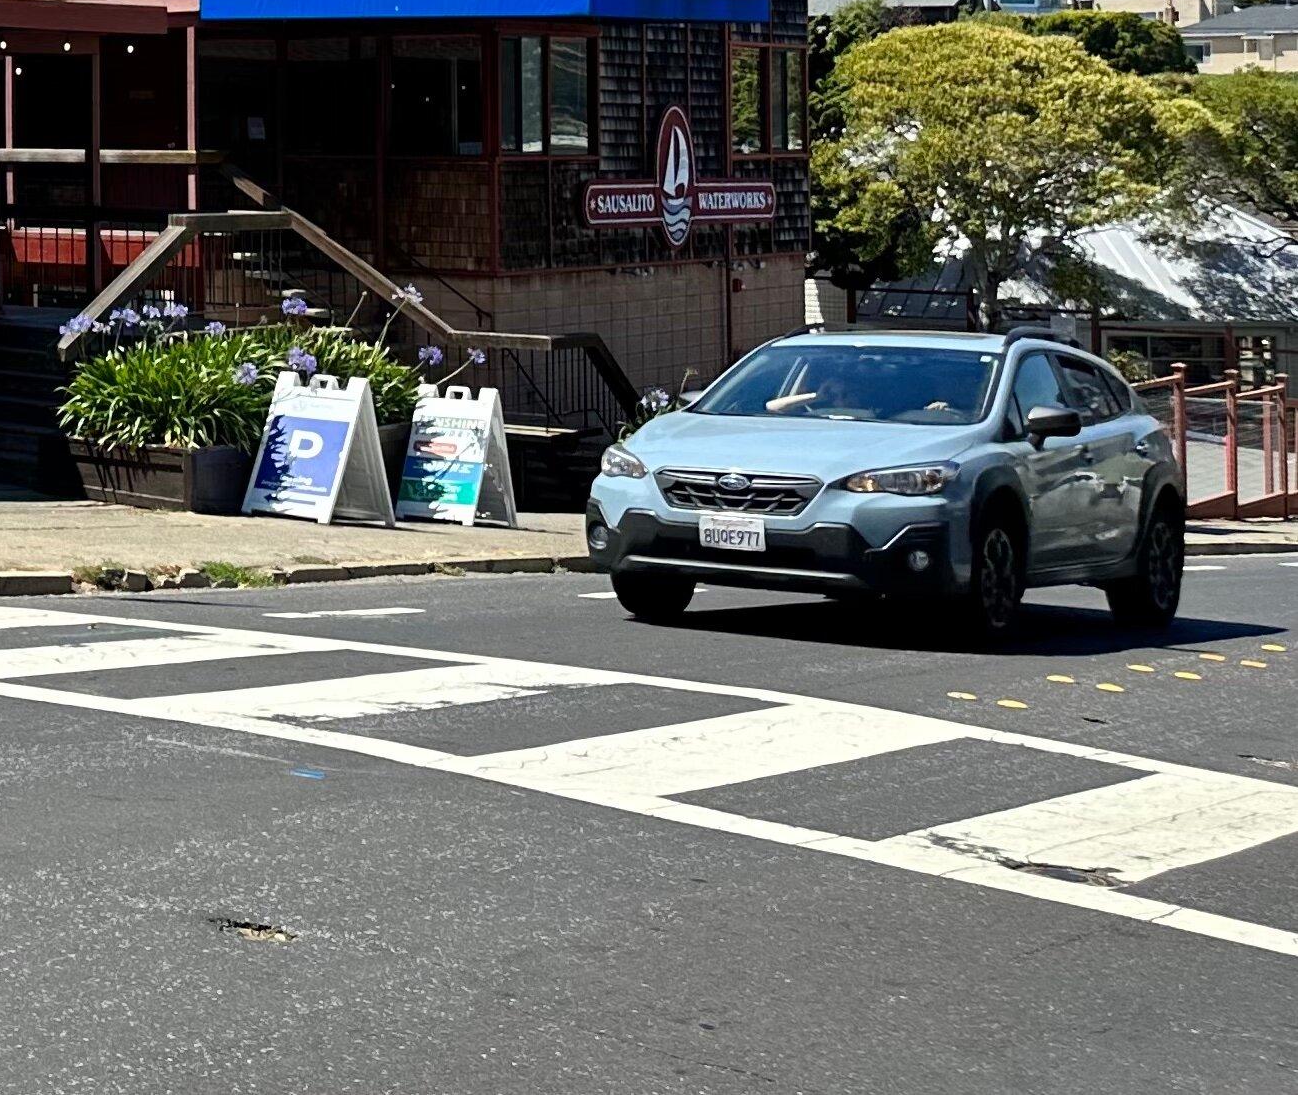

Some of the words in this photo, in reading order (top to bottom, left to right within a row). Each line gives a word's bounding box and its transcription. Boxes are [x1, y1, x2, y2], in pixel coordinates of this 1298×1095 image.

[597, 193, 655, 213] SAUSALITO
[698, 192, 766, 209] WATERWORKS
[288, 429, 324, 459] P
[704, 528, 760, 547] 8UQE977
